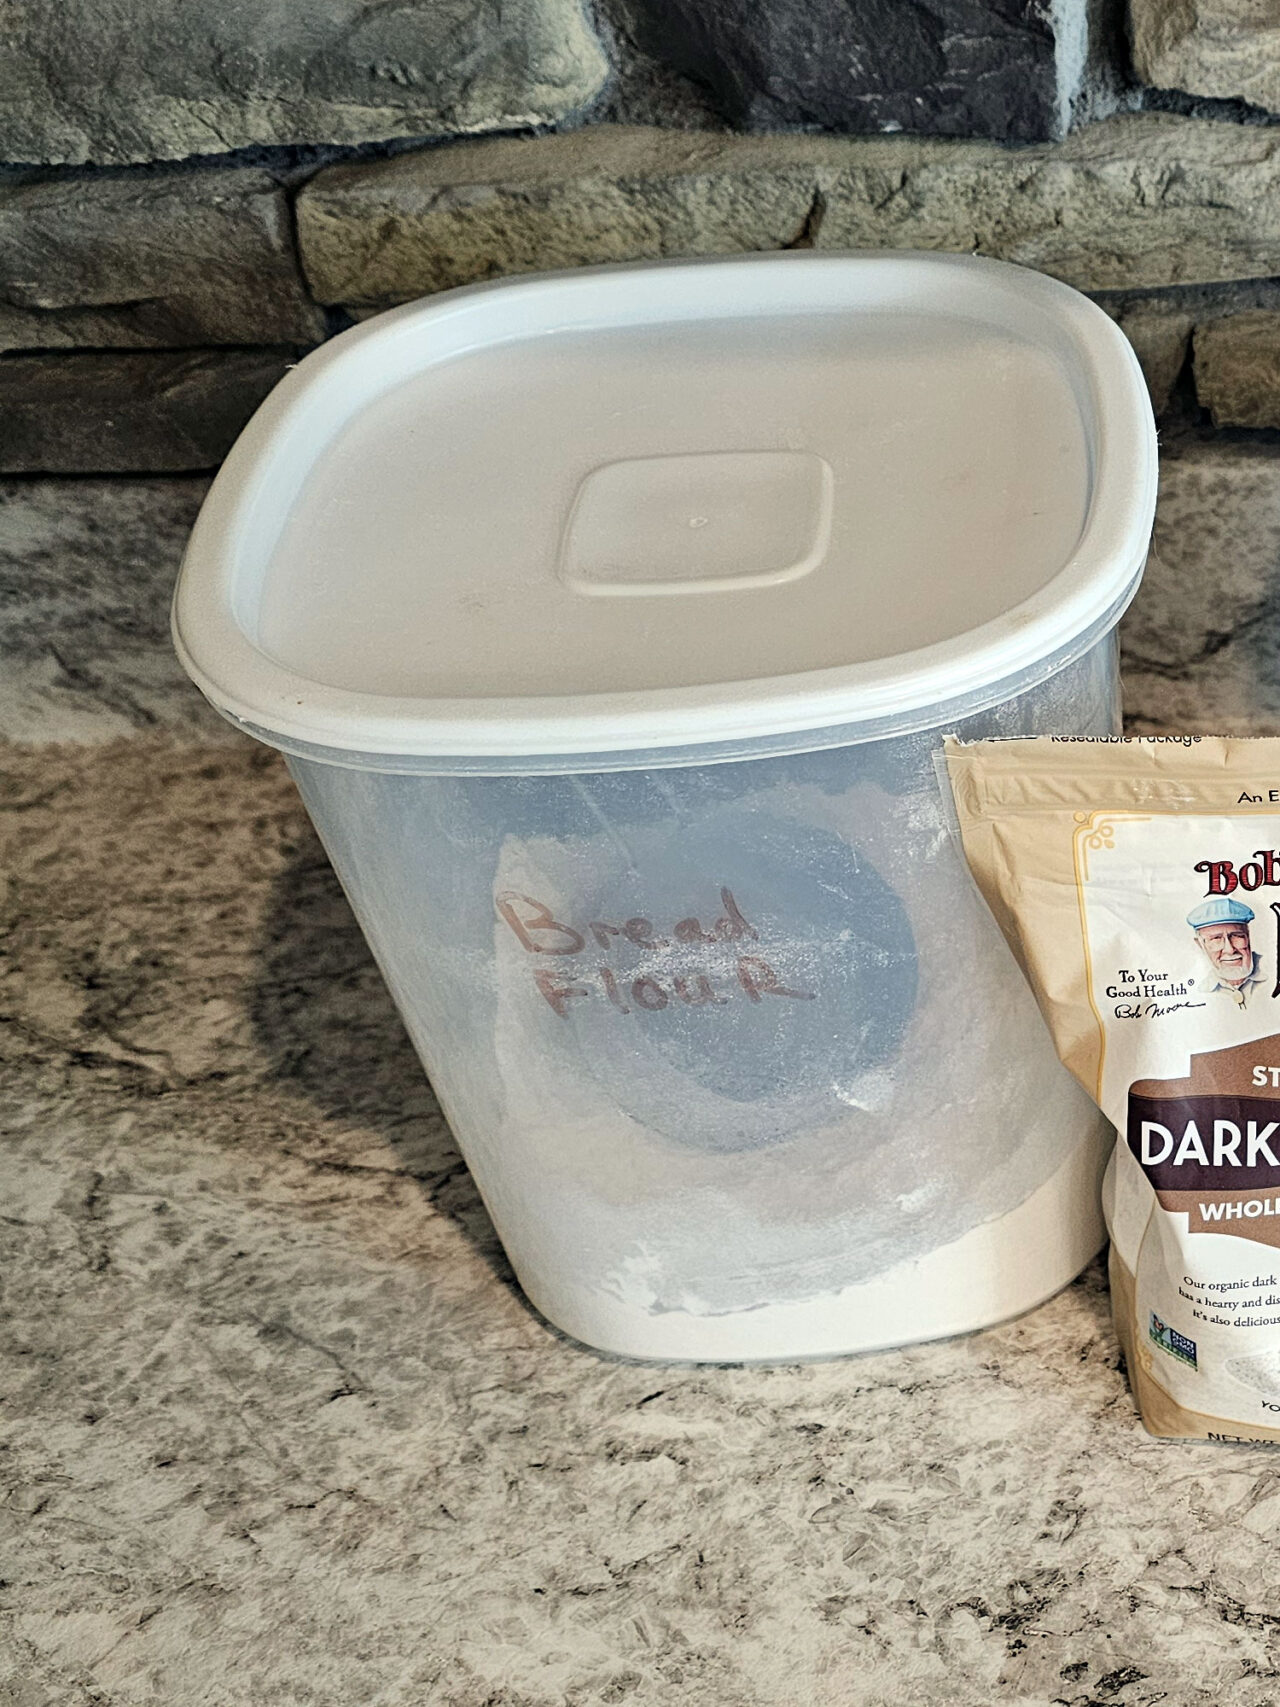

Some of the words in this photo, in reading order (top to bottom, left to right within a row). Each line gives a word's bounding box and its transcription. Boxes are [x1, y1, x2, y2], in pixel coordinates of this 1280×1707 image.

[1237, 791, 1262, 803] An
[1118, 970, 1135, 983] To
[1138, 969, 1169, 982] Your
[1106, 985, 1141, 998] Good
[1140, 1120, 1280, 1168] DARK
[1183, 1276, 1205, 1290] Our
[1208, 1279, 1250, 1293] organic
[1252, 1275, 1278, 1287] dark
[1178, 1286, 1194, 1301] has
[1196, 1297, 1203, 1305] a
[1204, 1297, 1239, 1311] hearty
[1242, 1296, 1262, 1308] and
[1210, 1315, 1231, 1326] also
